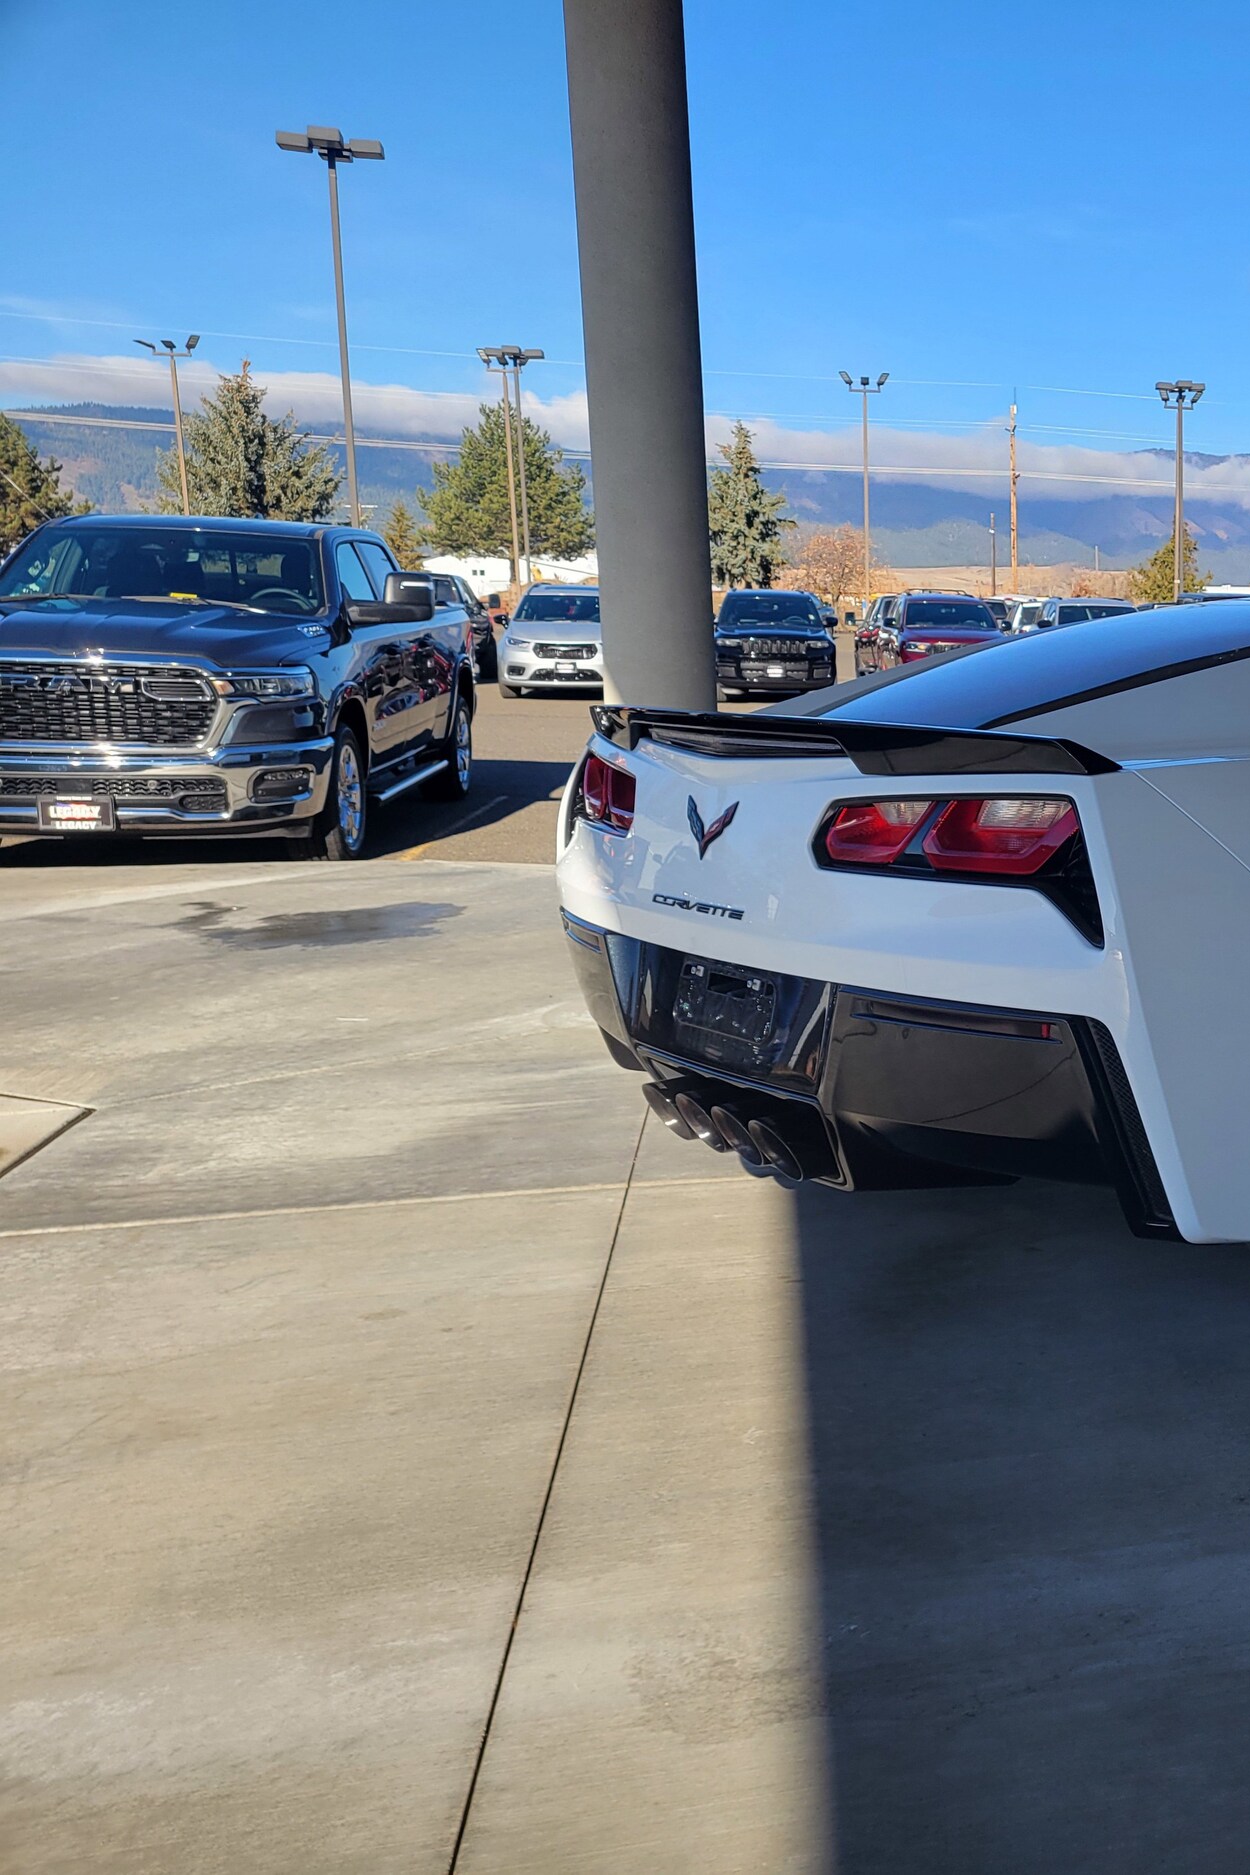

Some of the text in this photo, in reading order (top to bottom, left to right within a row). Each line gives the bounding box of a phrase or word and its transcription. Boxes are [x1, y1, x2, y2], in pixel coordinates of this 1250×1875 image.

[0, 674, 135, 693] RAM
[49, 805, 101, 819] LEGACY
[55, 820, 97, 830] LEGACY
[652, 893, 745, 921] CORVETTE
